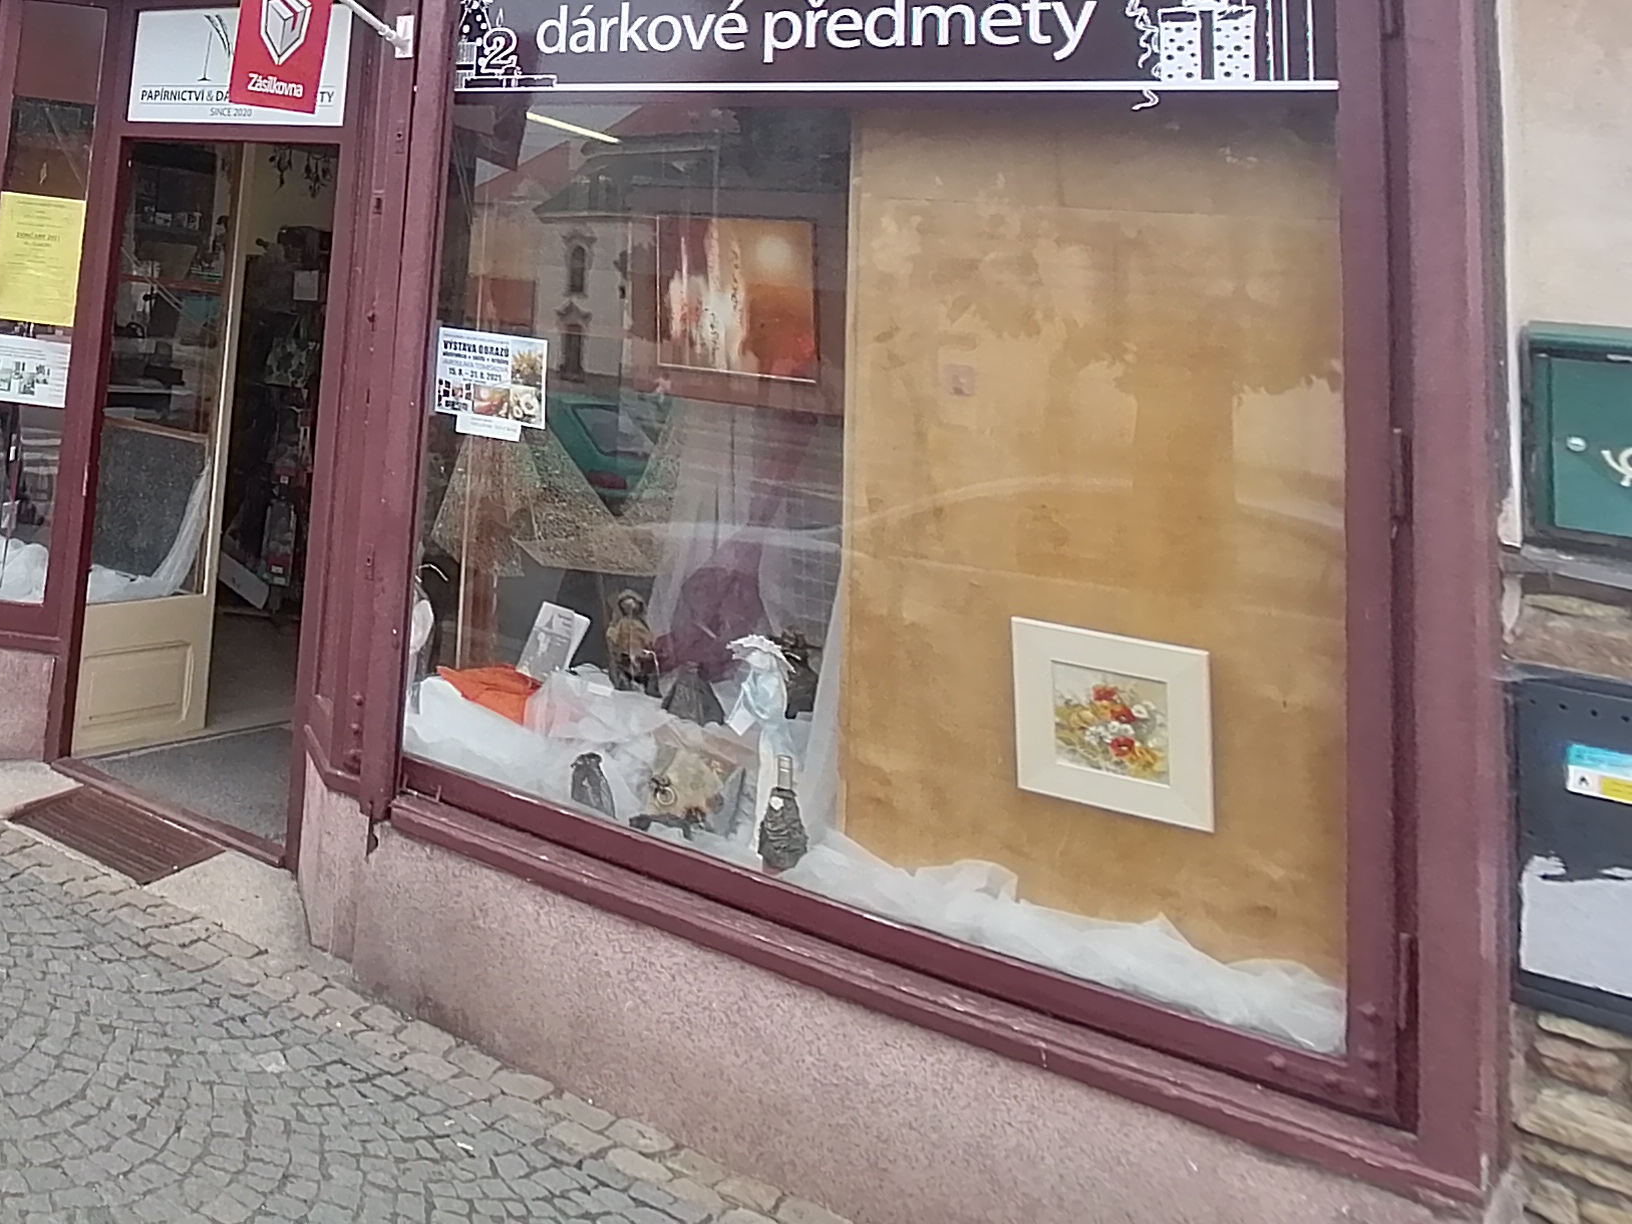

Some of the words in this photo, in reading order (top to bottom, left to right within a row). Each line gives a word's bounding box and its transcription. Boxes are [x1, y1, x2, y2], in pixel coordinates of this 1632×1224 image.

[535, 0, 748, 55] dárkové
[247, 72, 303, 98] Zásilkovna
[141, 87, 205, 102] PAPÍRNICTVÍ
[206, 90, 214, 102] &
[210, 107, 231, 118] SINCE
[233, 107, 252, 118] 2020
[443, 339, 477, 353] VÝSTAVA
